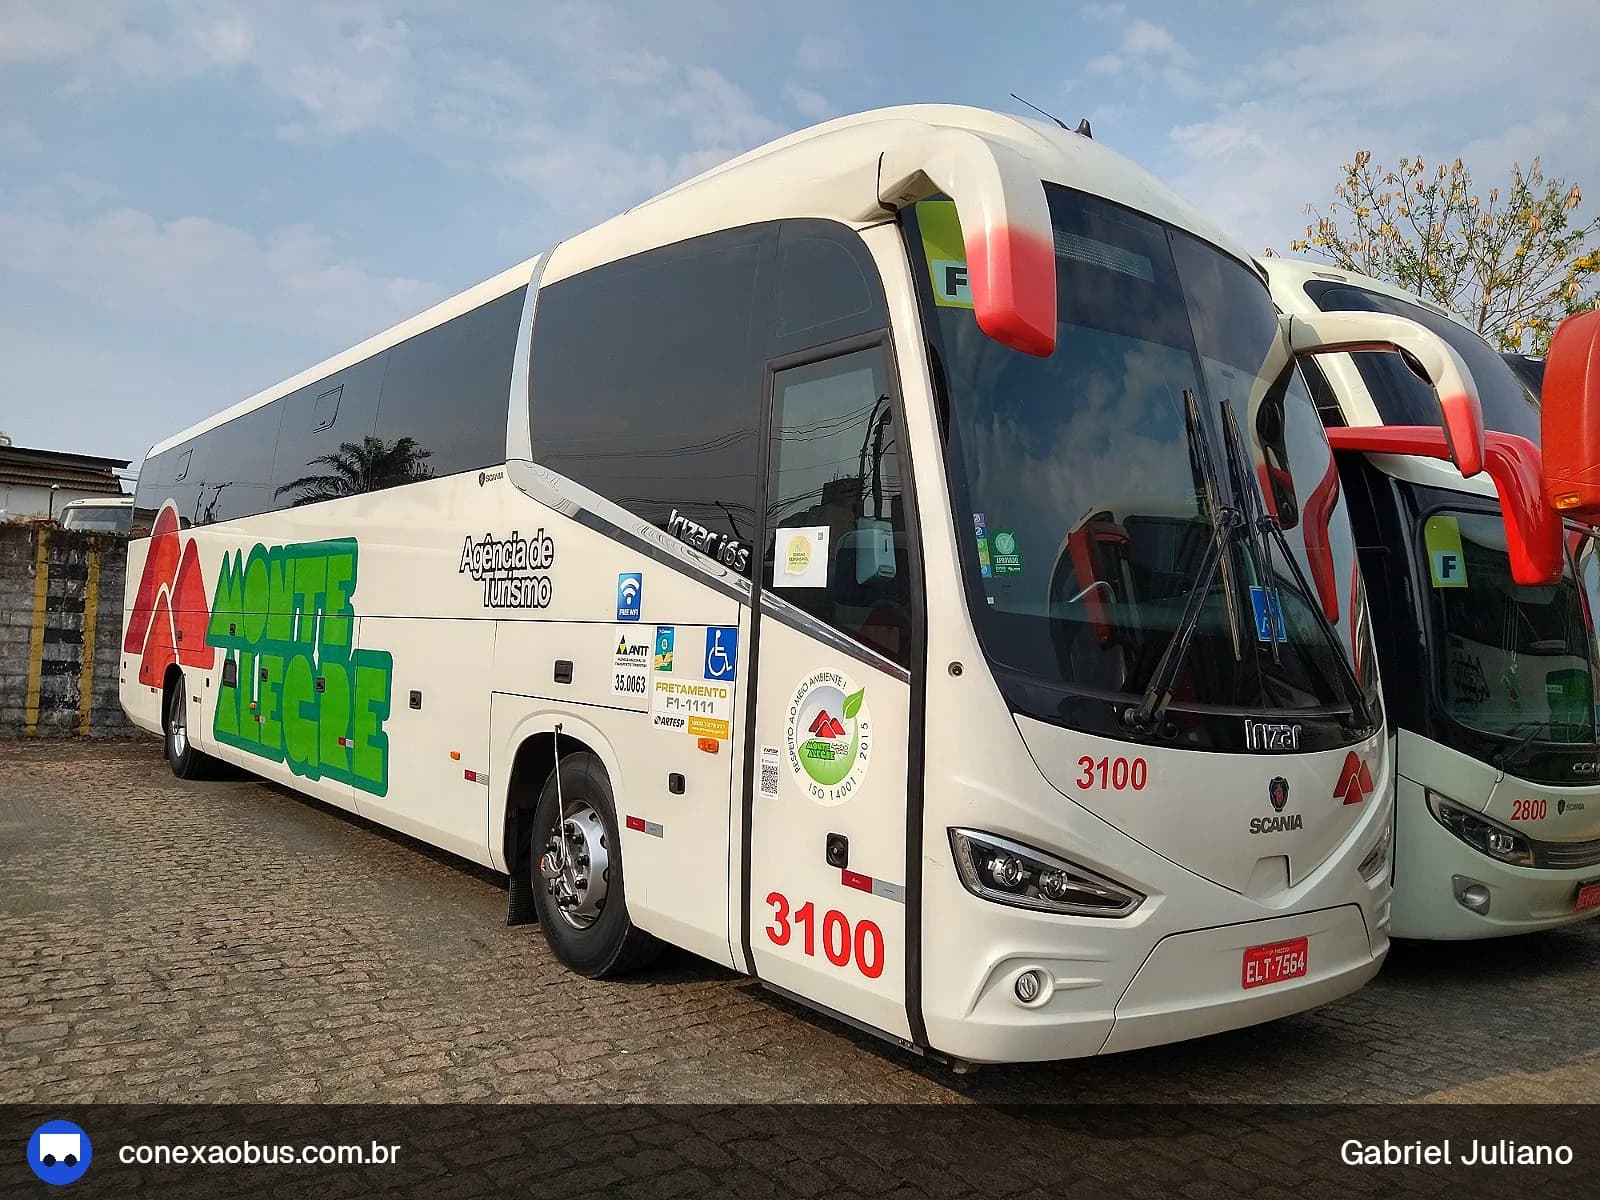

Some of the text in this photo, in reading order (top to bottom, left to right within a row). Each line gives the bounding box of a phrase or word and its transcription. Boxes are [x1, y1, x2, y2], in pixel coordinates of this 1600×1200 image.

[945, 266, 968, 296] F
[459, 528, 554, 581] Agência de
[1442, 555, 1457, 579] F
[208, 546, 356, 647] MONTE
[481, 571, 552, 609] Turismo
[628, 645, 650, 657] ANTT
[614, 673, 646, 694] 35.0063
[656, 682, 727, 698] FRETAMENTO
[809, 672, 843, 687] AMBIENTE
[666, 696, 714, 714] F1-1111
[794, 682, 809, 707] MEIO
[214, 650, 390, 791] ALEGRE
[660, 716, 685, 728] ARTESP
[789, 706, 797, 725] AO
[787, 727, 801, 774] RESPEITO
[808, 783, 825, 799] ISO
[829, 776, 857, 800] 14001
[859, 722, 869, 761] 2015
[1075, 755, 1148, 792] 3100
[1511, 799, 1547, 820] 2800
[1249, 814, 1303, 835] SCANIA
[765, 891, 885, 979] 3100
